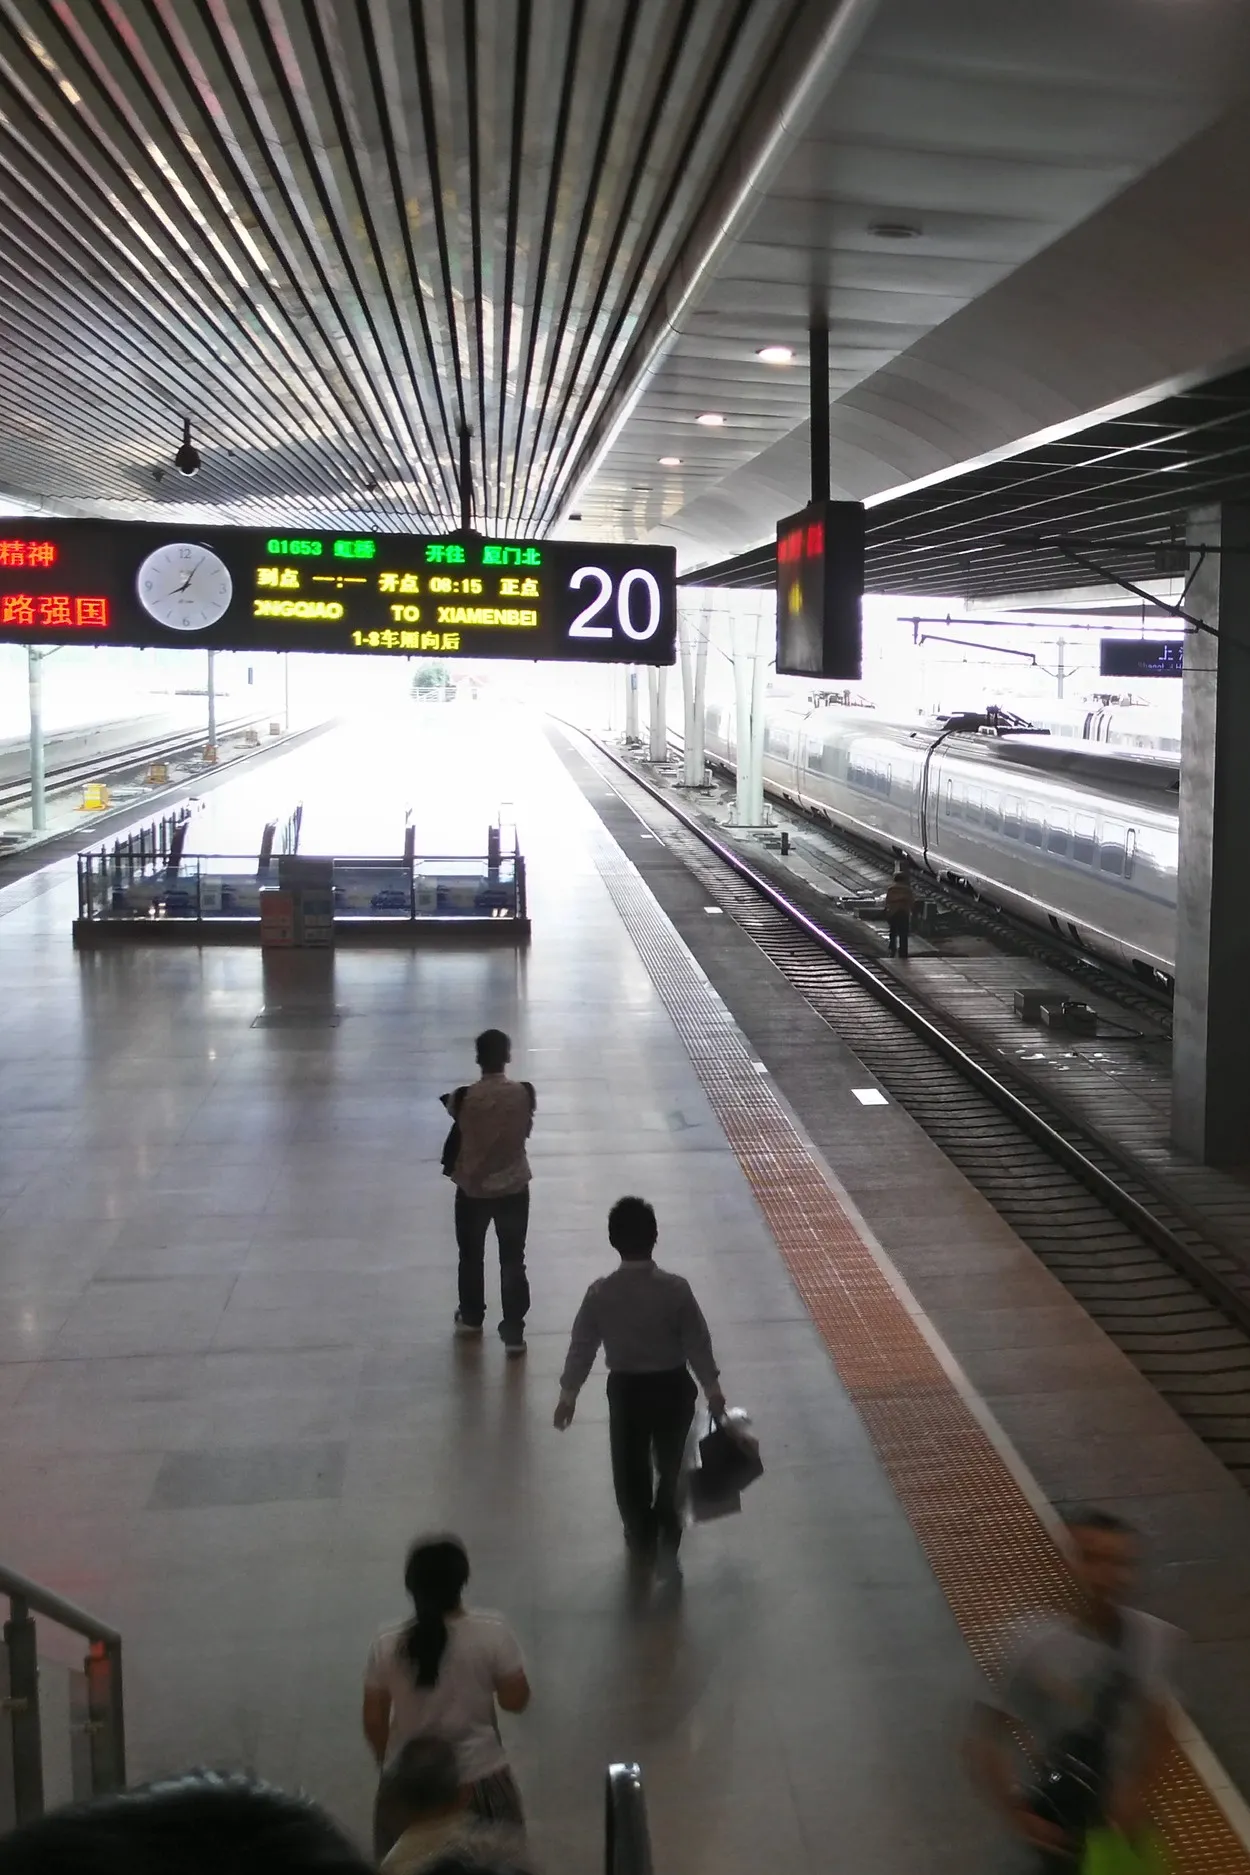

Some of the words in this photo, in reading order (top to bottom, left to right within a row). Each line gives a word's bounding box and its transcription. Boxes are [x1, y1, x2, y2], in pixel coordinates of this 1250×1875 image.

[0, 540, 54, 567] 精神
[179, 549, 192, 559] 12
[267, 539, 322, 556] G1653
[425, 545, 466, 563] 开往
[482, 545, 541, 565] 厦门北
[256, 567, 300, 588] 到点
[378, 573, 419, 593] 开点
[429, 577, 482, 594] 08:15
[499, 578, 540, 597] 正点
[1, 594, 107, 627] 路强国
[390, 605, 420, 622] TO
[437, 606, 537, 626] XIAMENBEI
[568, 566, 660, 641] 20
[182, 618, 190, 627] 6
